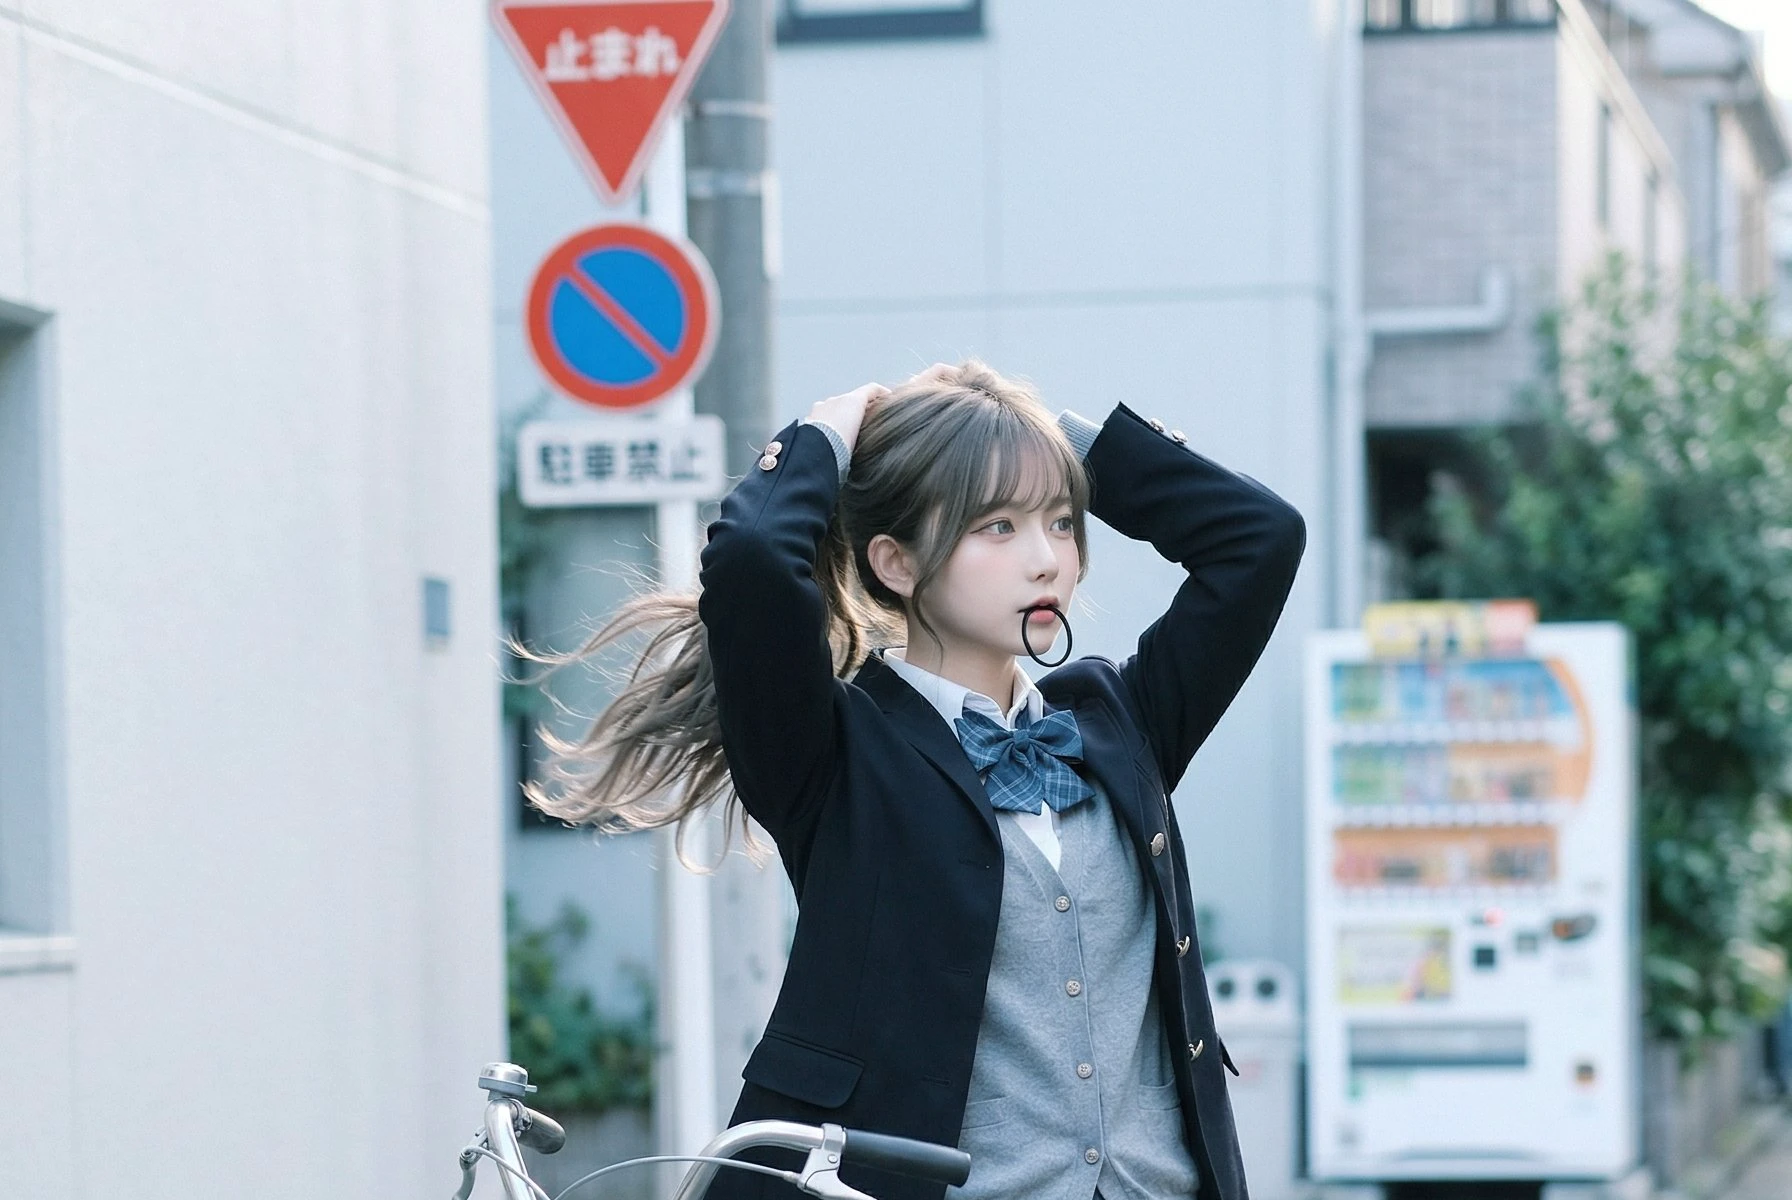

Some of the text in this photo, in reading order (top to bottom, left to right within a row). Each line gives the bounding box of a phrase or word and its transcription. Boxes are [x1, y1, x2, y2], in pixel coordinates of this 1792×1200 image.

[543, 27, 681, 82] 止まれ
[537, 438, 705, 485] 駐車禁止
